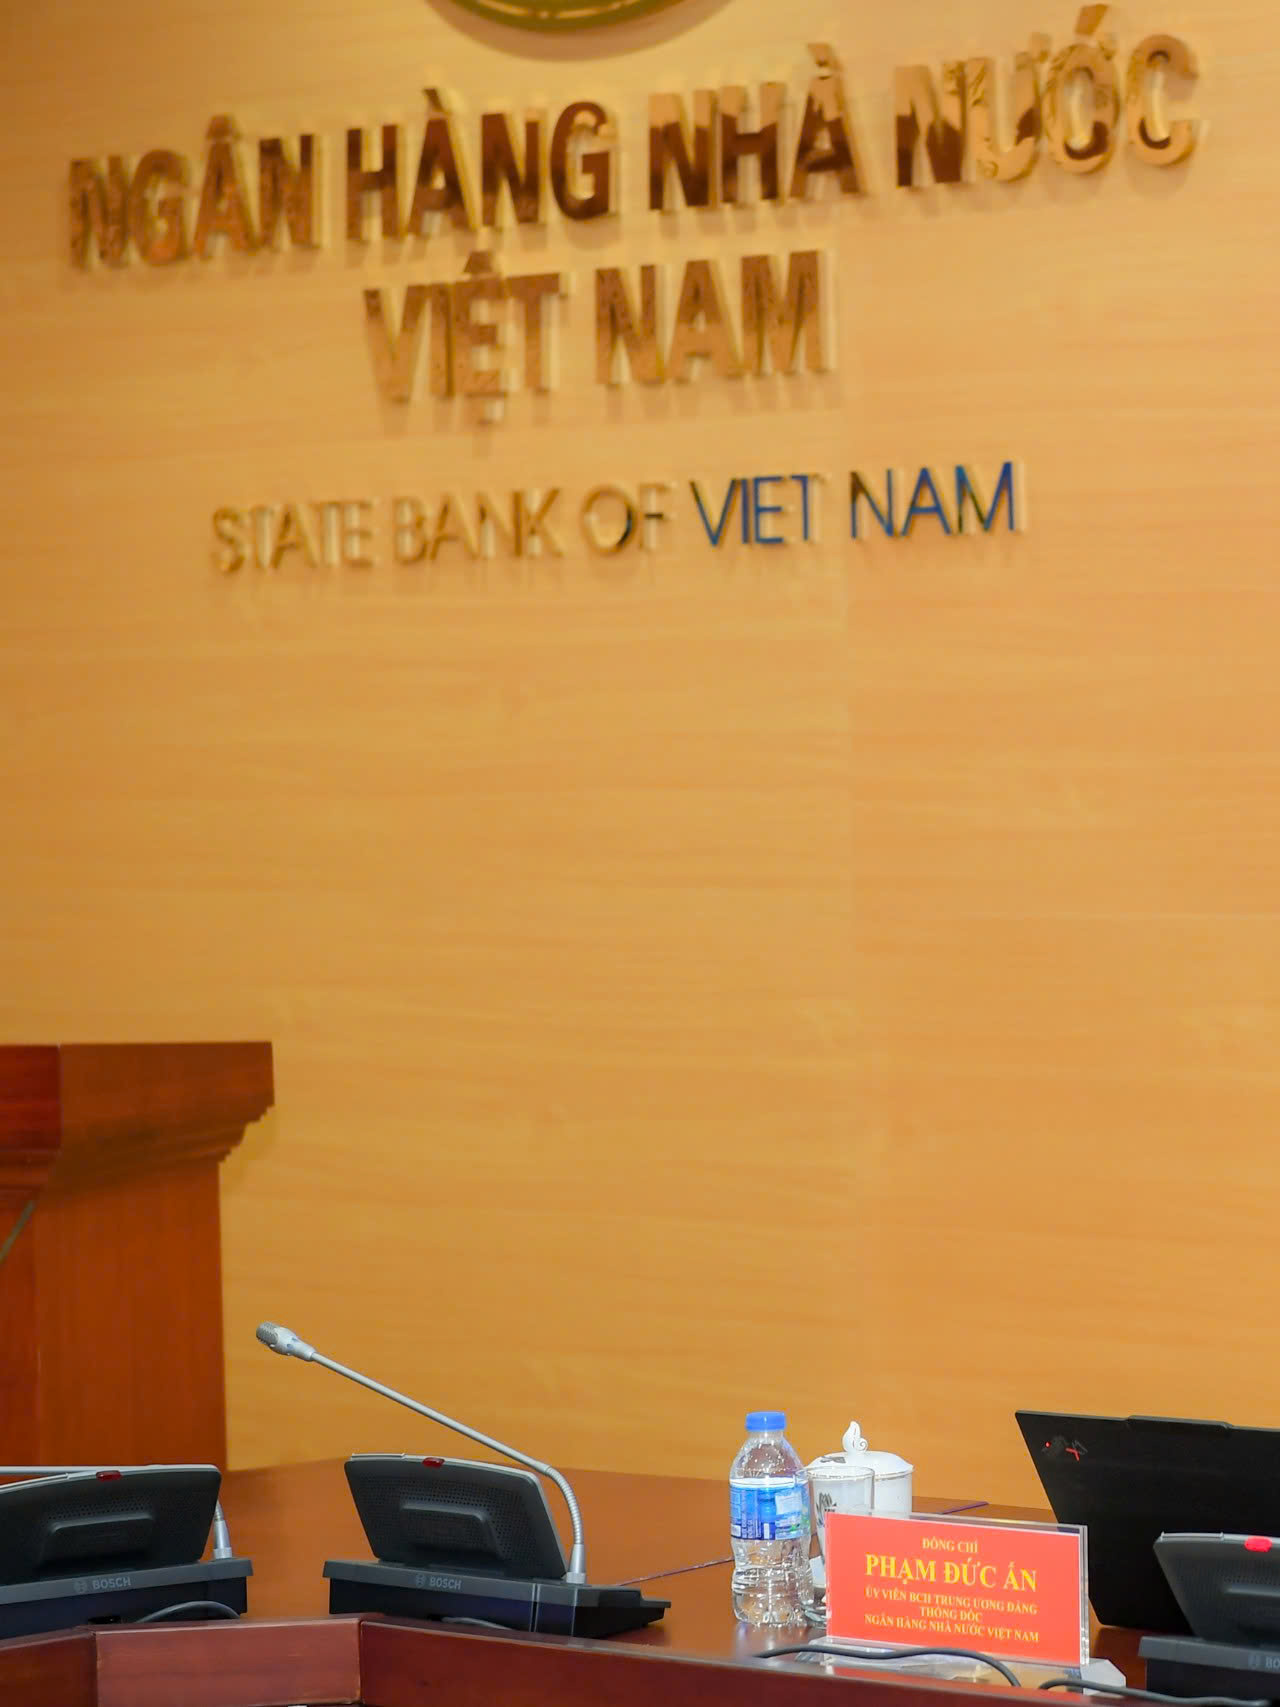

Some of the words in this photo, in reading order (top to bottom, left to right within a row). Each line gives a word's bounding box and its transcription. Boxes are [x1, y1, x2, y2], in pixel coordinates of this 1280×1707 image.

[68, 114, 318, 271] NGÂN
[346, 86, 614, 243] HÀNG
[647, 43, 864, 212] NHÀ
[894, 3, 1200, 188] NƯỚC
[363, 248, 568, 424] VIỆT
[597, 249, 832, 387] NAM
[211, 497, 377, 573] STATE
[395, 486, 567, 563] BANK
[582, 483, 674, 555] OF
[689, 474, 826, 547] VIET
[850, 461, 1017, 540] NAM
[92, 1576, 131, 1590] BOSCH
[429, 1575, 462, 1590] BOSCH
[865, 1554, 937, 1585] PHẠM
[944, 1557, 997, 1588] ĐỨC
[934, 1595, 970, 1609] TRUNG
[1014, 1629, 1039, 1642] NAM
